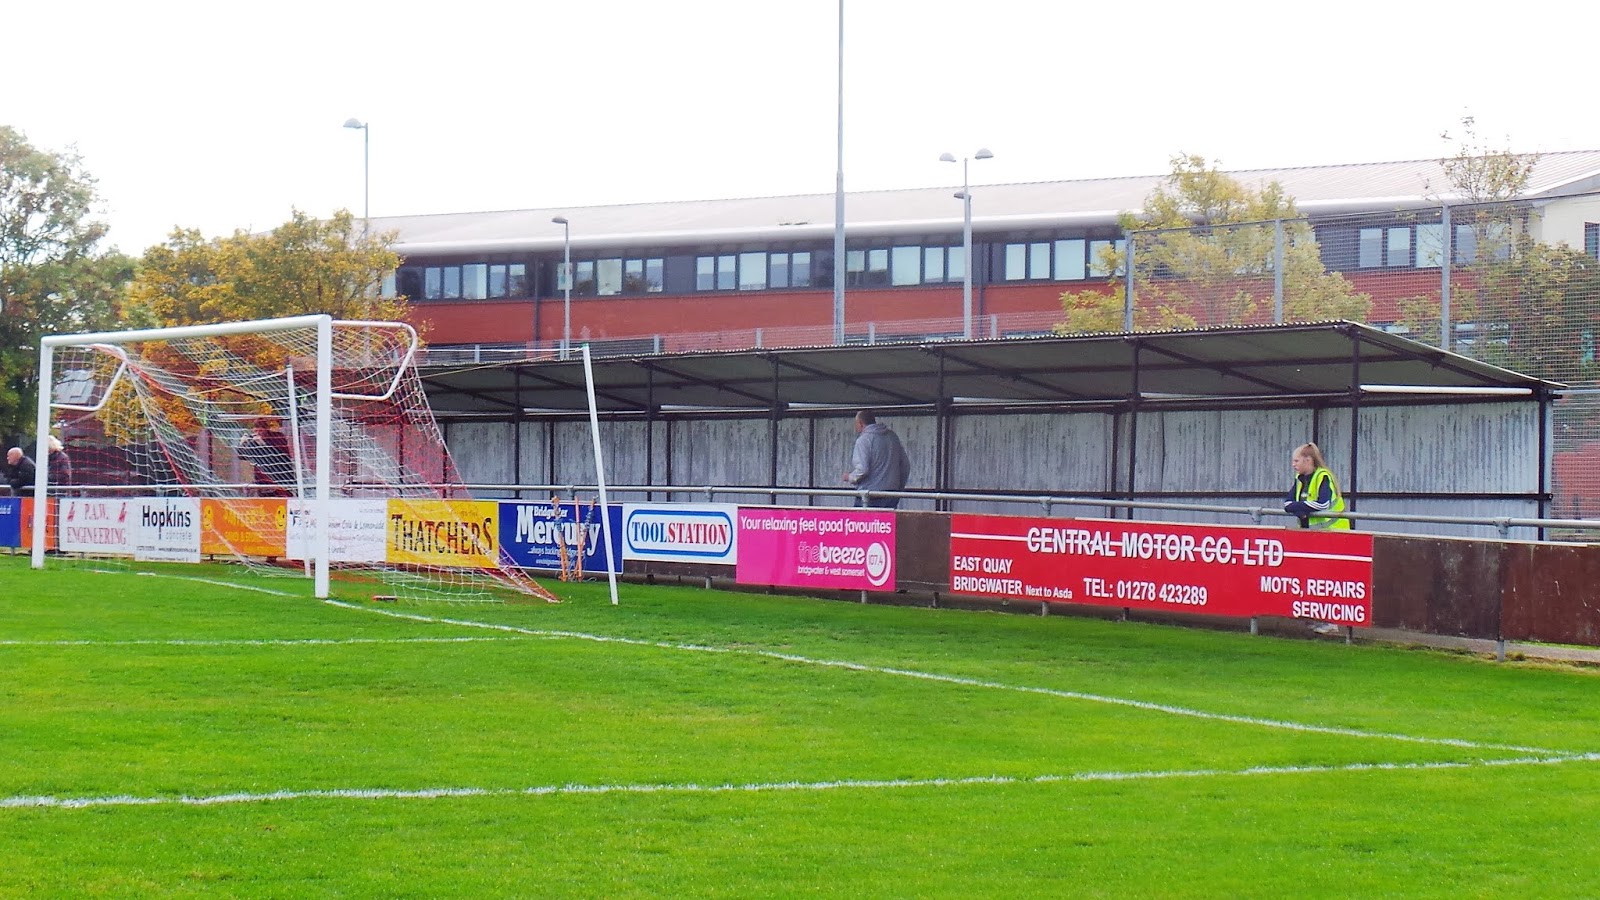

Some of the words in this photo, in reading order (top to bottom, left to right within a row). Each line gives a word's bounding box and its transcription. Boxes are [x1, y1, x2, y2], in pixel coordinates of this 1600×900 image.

[142, 500, 191, 539] Hopkins
[741, 516, 761, 530] Your
[762, 517, 797, 535] relaxing
[799, 517, 817, 534] feel
[819, 518, 844, 535] good
[845, 518, 892, 536] favourites
[67, 527, 126, 545] ENGINEERING
[391, 514, 493, 555] THATCHERS
[631, 522, 728, 545] TOOLSTATION
[1027, 527, 1117, 557] CENTRAL
[1121, 532, 1196, 562] MOTOR
[1243, 538, 1284, 567] LTD
[797, 566, 825, 576] bridgwater
[829, 568, 842, 576] west
[842, 568, 866, 577] somerset
[953, 556, 981, 572] EAST
[983, 558, 1013, 574] QUAY
[953, 576, 1023, 595] BRIDGWATER
[1025, 585, 1043, 597] Next
[1044, 587, 1052, 598] to
[1053, 587, 1073, 599] Asda
[1083, 577, 1114, 598] TEL:
[1117, 580, 1156, 601] 01278
[1159, 583, 1208, 606] 423289
[1260, 576, 1304, 598] MOT'S,
[1307, 578, 1366, 599] REPAIRS
[1292, 601, 1365, 623] SERVICING
